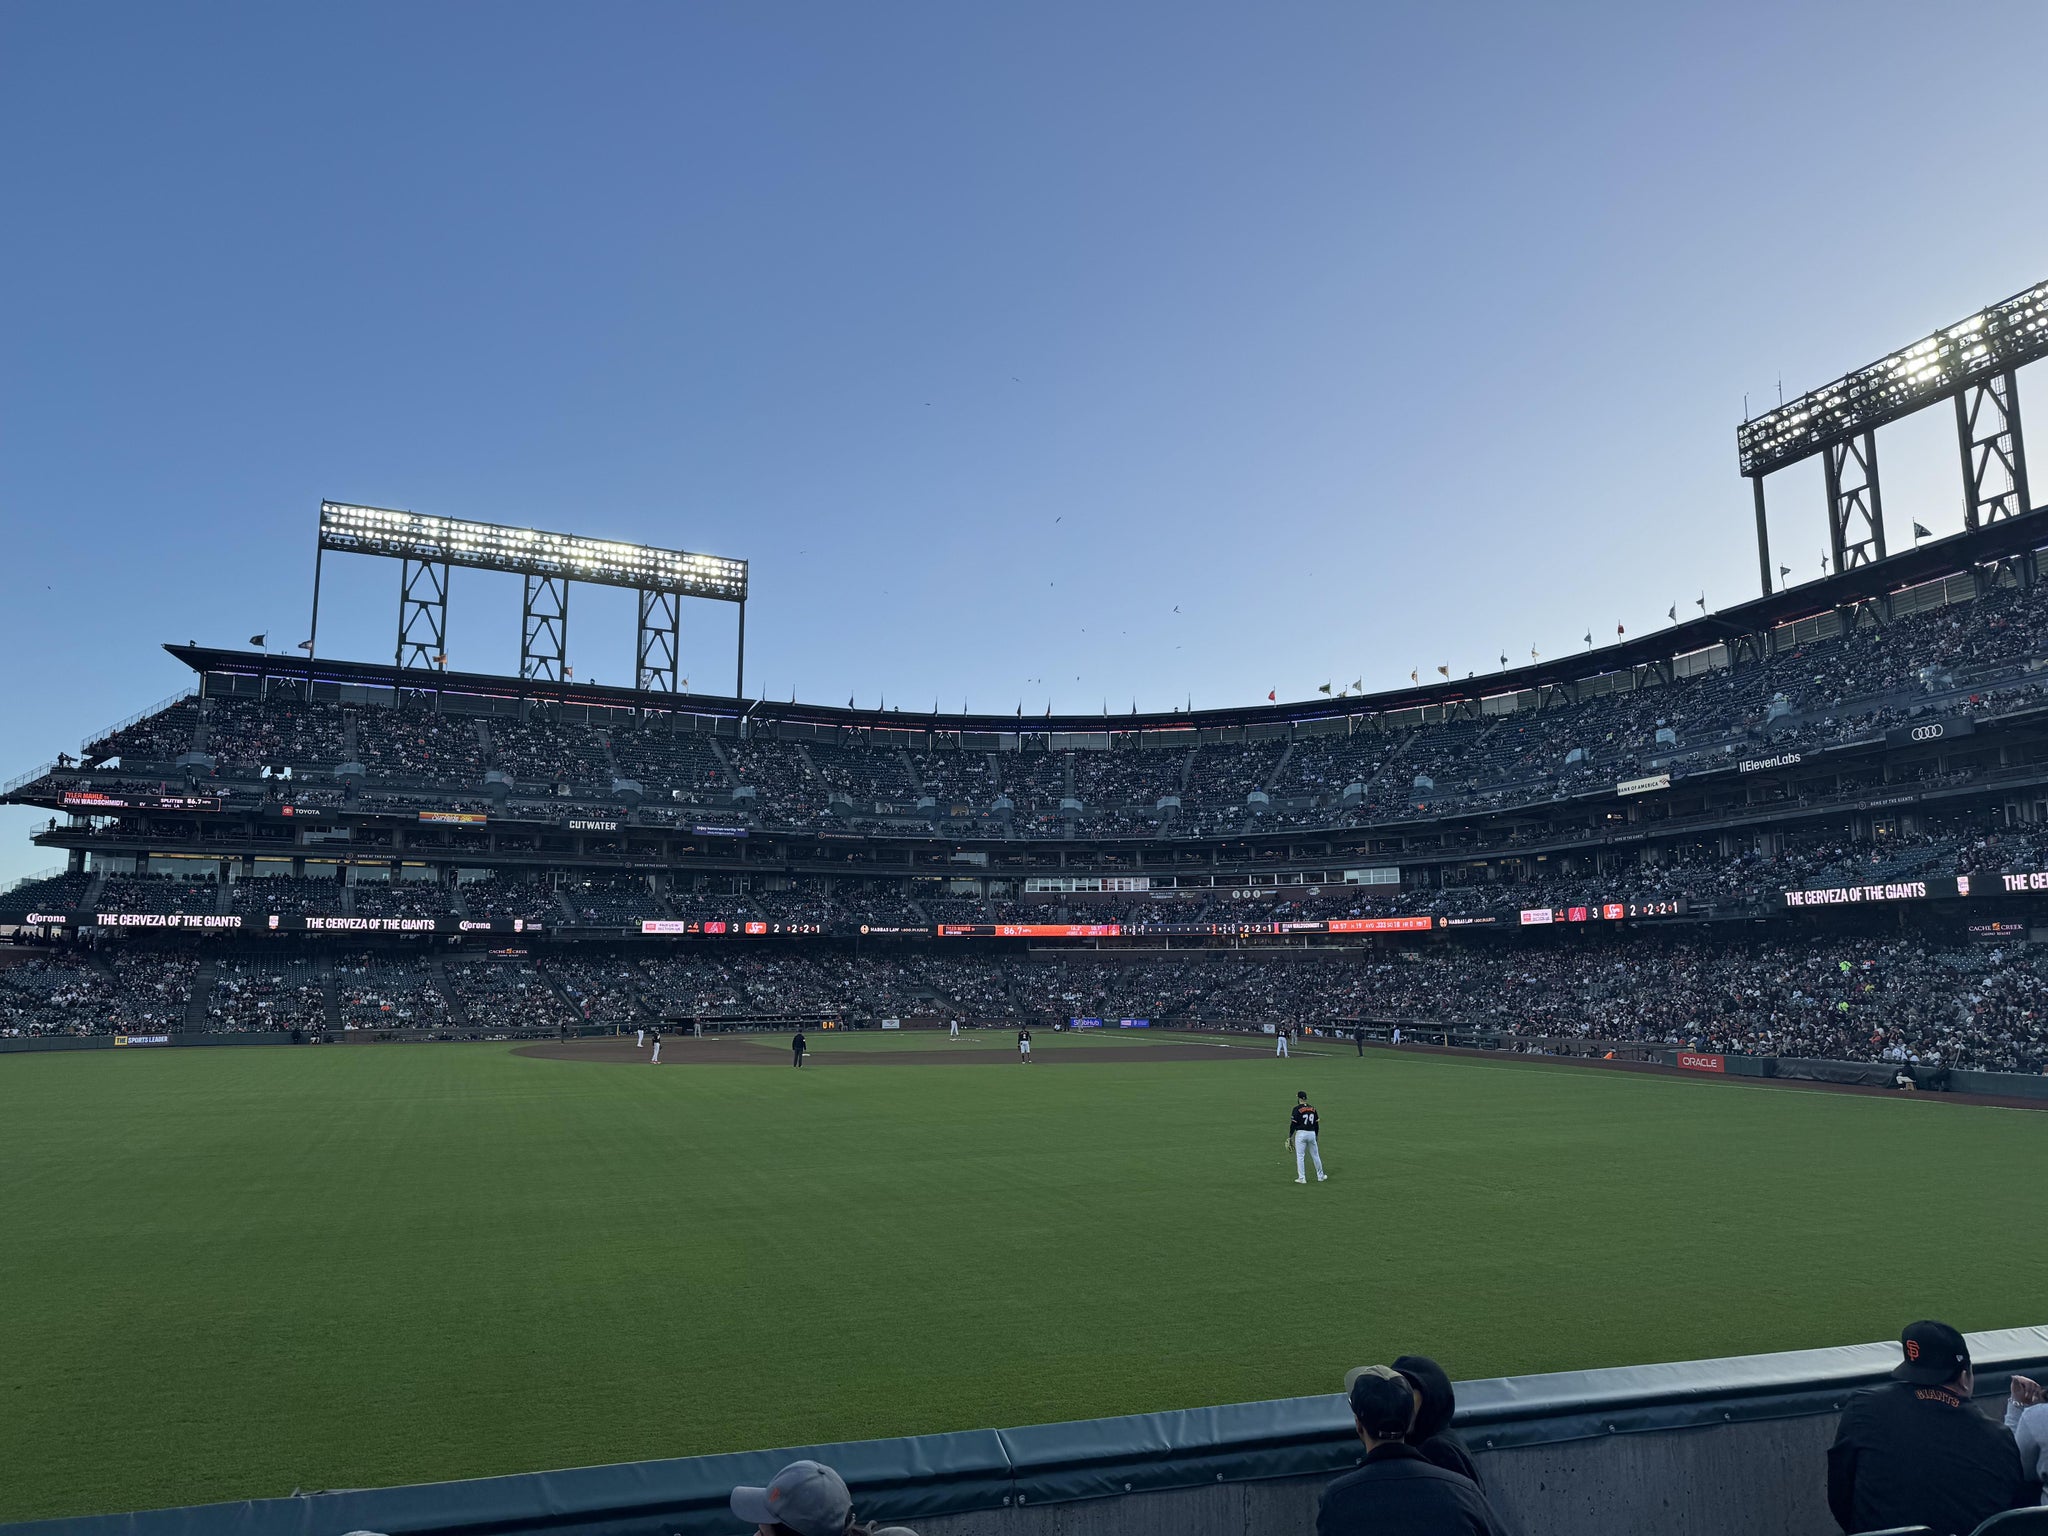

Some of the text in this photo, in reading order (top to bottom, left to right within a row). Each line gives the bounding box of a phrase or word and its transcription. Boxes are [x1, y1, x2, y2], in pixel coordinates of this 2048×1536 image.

[1638, 782, 1658, 790] AMERICA
[570, 820, 616, 830] CUTWATER
[2002, 874, 2028, 891] THE
[1785, 882, 1926, 906] THE CERVEZA OF THE GIANTS
[1592, 908, 1598, 918] 3
[1630, 905, 1636, 916] 2
[1648, 904, 1654, 914] 2
[1660, 903, 1666, 914] 2
[1673, 902, 1678, 913] 1
[26, 913, 66, 924] Corona
[97, 914, 241, 927] THE CERVEZA OF THE GIANTS
[306, 918, 435, 930] THE CERVEZA OF THE GIANTS
[459, 920, 491, 931] Corona
[732, 923, 739, 932] 3
[774, 924, 780, 932] 2
[791, 924, 797, 933] 2
[804, 924, 809, 933] 2
[816, 925, 820, 933] 1
[1004, 926, 1021, 935] 86.7
[1682, 1057, 1717, 1068] ORACLE
[1302, 1114, 1314, 1125] 79
[1914, 1388, 1960, 1408] GIANTS
